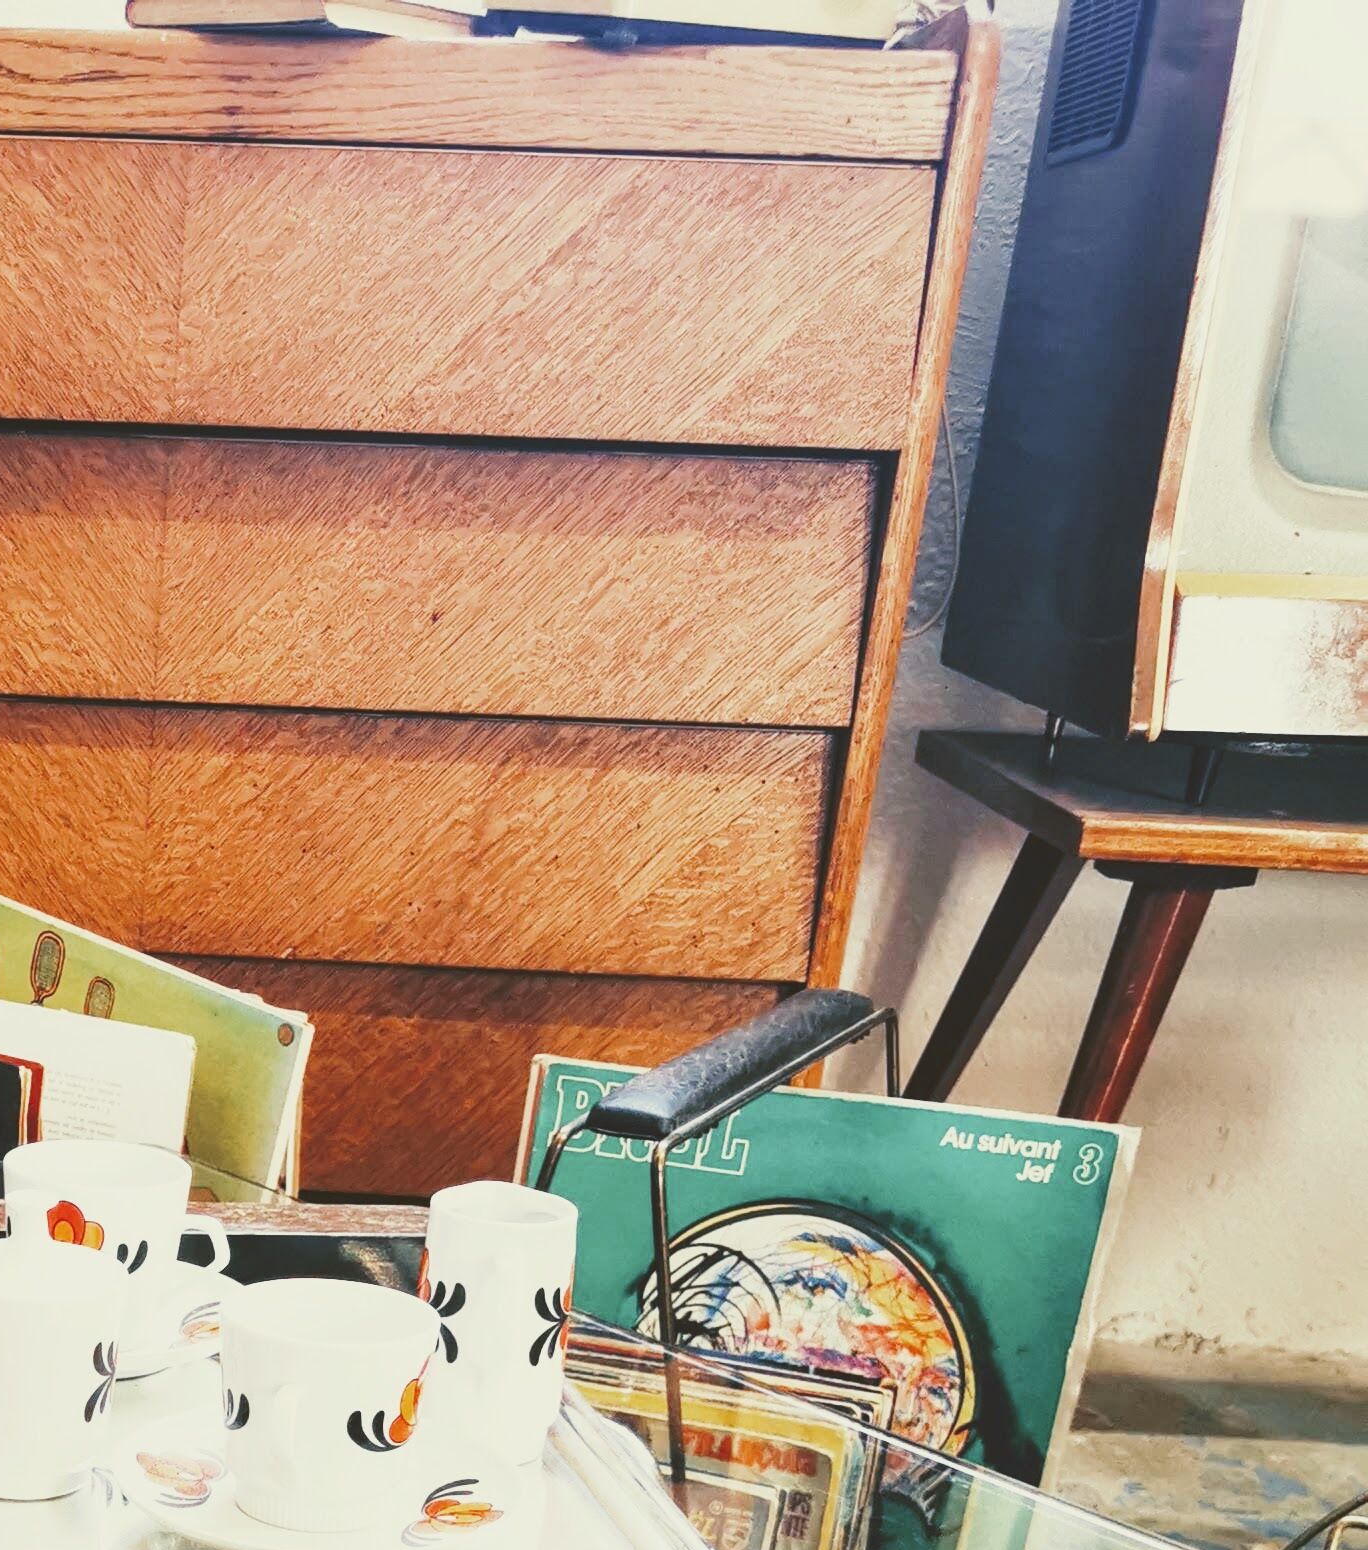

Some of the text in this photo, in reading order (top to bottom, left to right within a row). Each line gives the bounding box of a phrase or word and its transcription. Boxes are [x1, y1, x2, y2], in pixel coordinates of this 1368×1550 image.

[547, 1075, 750, 1176] BL
[939, 1126, 1062, 1161] Au suivant
[1015, 1160, 1056, 1184] Jef
[1072, 1143, 1104, 1185] 3
